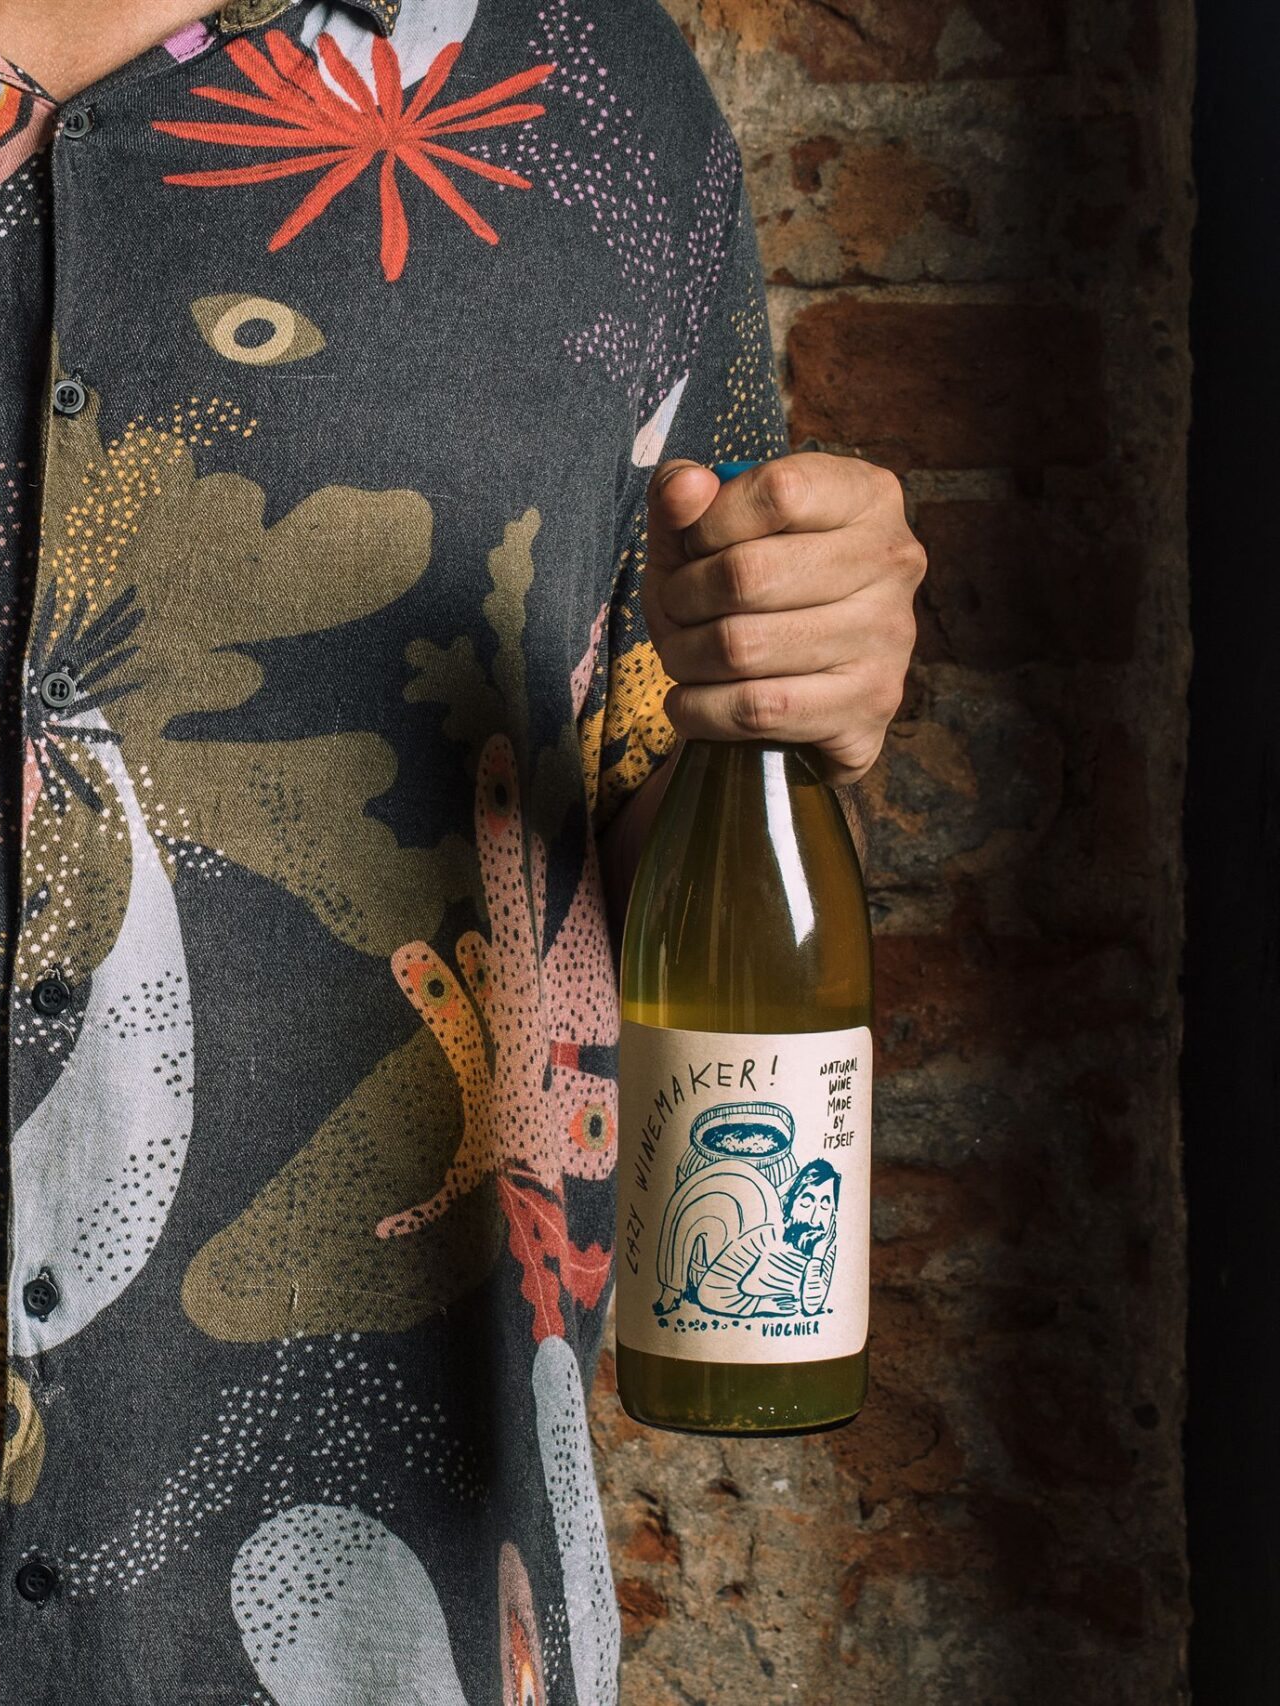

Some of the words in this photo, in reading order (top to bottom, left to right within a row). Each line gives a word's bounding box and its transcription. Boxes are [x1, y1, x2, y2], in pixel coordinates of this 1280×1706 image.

[819, 1057, 858, 1076] NATURAL
[827, 1096, 852, 1116] MADE
[833, 1114, 845, 1132] BY
[625, 1203, 645, 1275] LAZY
[635, 1055, 778, 1192] WINEMAKER!
